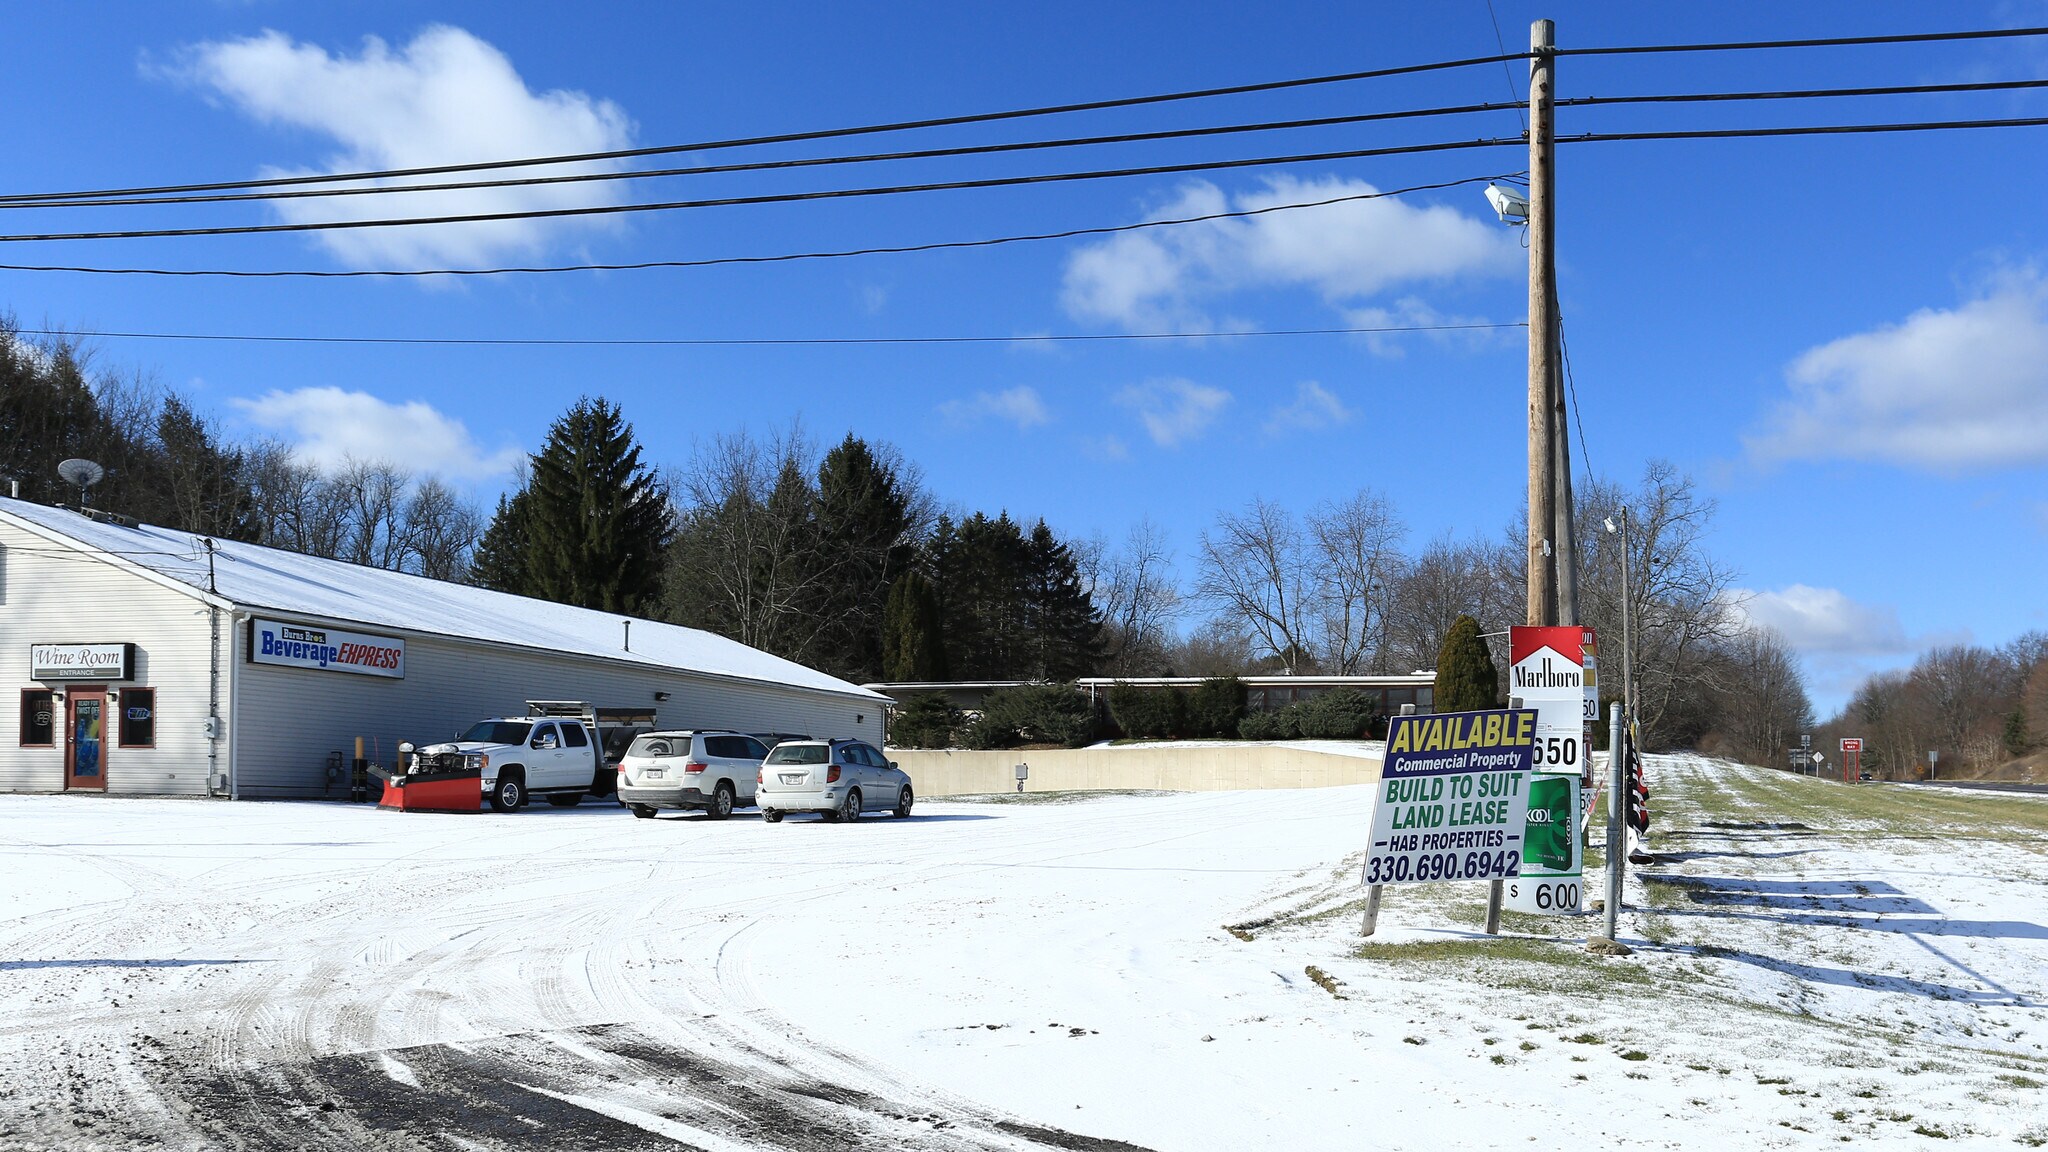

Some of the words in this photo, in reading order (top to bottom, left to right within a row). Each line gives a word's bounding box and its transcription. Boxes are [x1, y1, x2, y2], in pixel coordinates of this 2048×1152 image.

[261, 630, 337, 667] Beverage
[337, 643, 402, 669] EXPRESS
[283, 628, 304, 640] Burns
[305, 631, 325, 643] Bros.
[36, 648, 75, 665] Wine
[78, 648, 119, 668] Room
[1514, 657, 1580, 688] Marlboro
[1391, 712, 1534, 753] AVAILABLE
[1395, 753, 1468, 772] Commercial
[1470, 751, 1522, 769] Property
[1386, 777, 1444, 803] BUILD
[1450, 774, 1473, 799] TO
[1478, 772, 1523, 798] SUIT
[1392, 805, 1444, 830] LAND
[1449, 800, 1509, 826] LEASE
[1526, 809, 1554, 823] KOOL
[1389, 834, 1418, 852] HAB
[1422, 829, 1504, 850] PROPERTIES
[1367, 850, 1520, 883] 330.690.6942
[1510, 884, 1518, 898] $
[1536, 883, 1578, 911] 6.00
